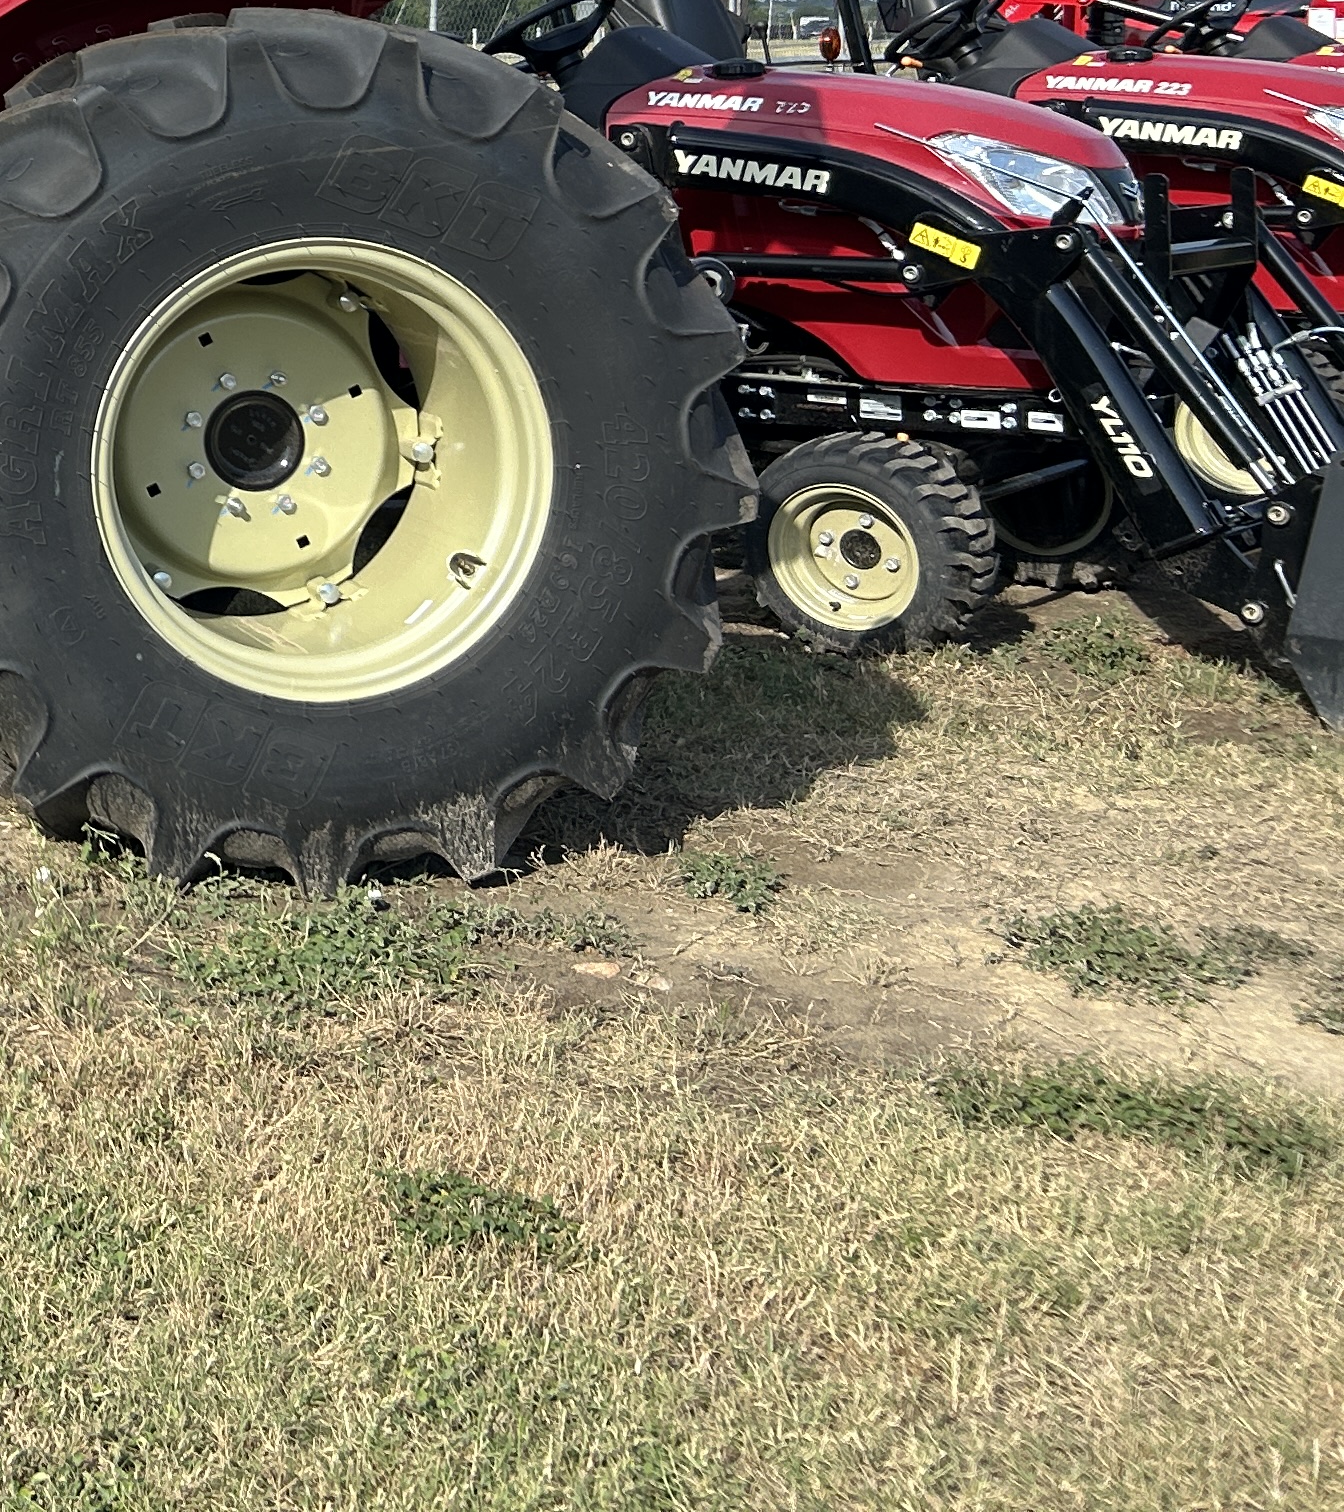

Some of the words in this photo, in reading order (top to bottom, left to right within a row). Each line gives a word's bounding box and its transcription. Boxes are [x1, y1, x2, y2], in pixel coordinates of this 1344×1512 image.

[647, 91, 764, 112] YANMAR
[1045, 75, 1154, 93] YANMAR
[1154, 82, 1192, 96] 223
[1098, 116, 1243, 150] YANMAR
[674, 149, 830, 194] YANMAR
[315, 134, 541, 260] BKT
[1091, 396, 1154, 478] YL110
